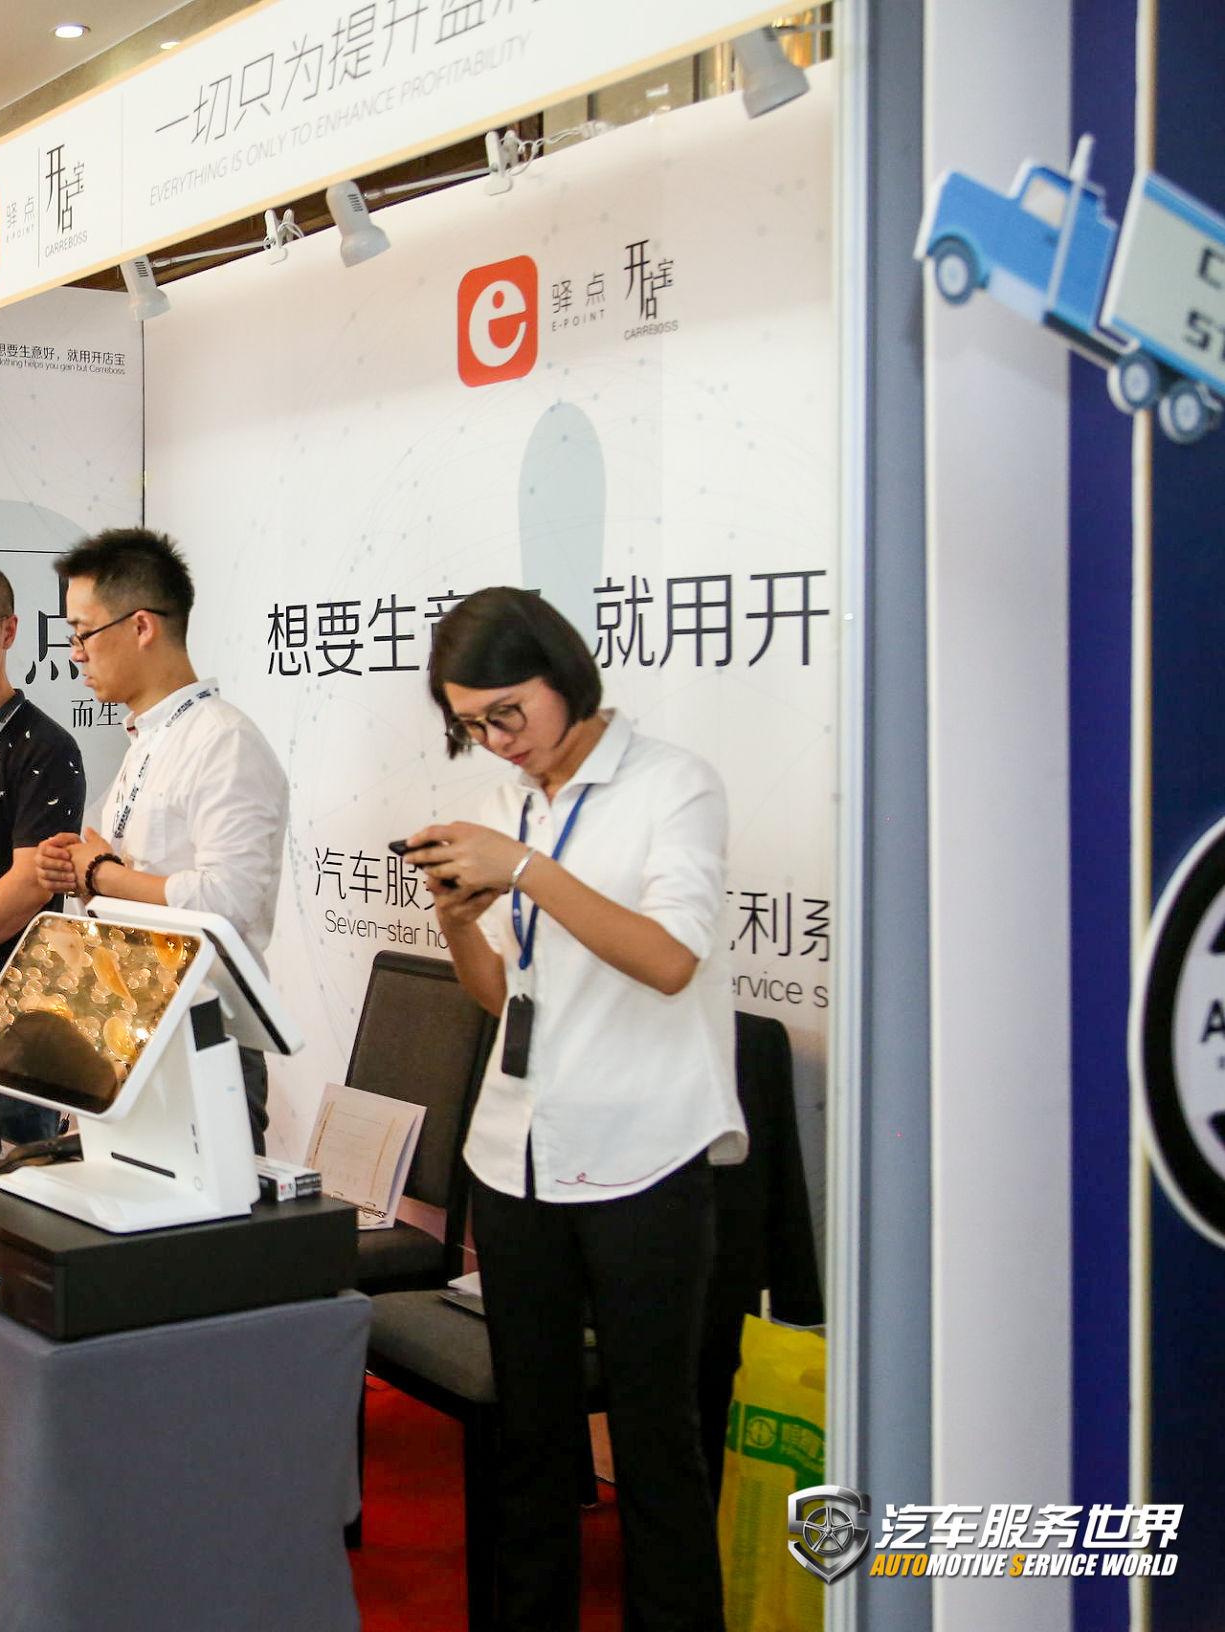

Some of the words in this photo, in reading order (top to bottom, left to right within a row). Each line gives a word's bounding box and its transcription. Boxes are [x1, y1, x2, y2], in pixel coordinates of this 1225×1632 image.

[155, 0, 539, 144] 一切只为提升盈
[150, 157, 228, 206] EVERYTHING
[231, 150, 244, 173] IS
[246, 132, 289, 168] ONLY
[291, 121, 313, 146] TO
[315, 86, 395, 139] ENHANCE
[400, 29, 533, 104] PROFITABILITY
[44, 230, 88, 258] CARREBOSS
[551, 271, 606, 314] 驿点
[551, 309, 606, 332] E-POINT
[624, 319, 679, 341] CARREBOSS
[267, 588, 541, 678] 想要生
[71, 698, 123, 728] 而生
[315, 847, 436, 911] 汽车服
[325, 909, 421, 945] Seven-star
[726, 891, 830, 962] 利系
[732, 970, 803, 1004] rvice
